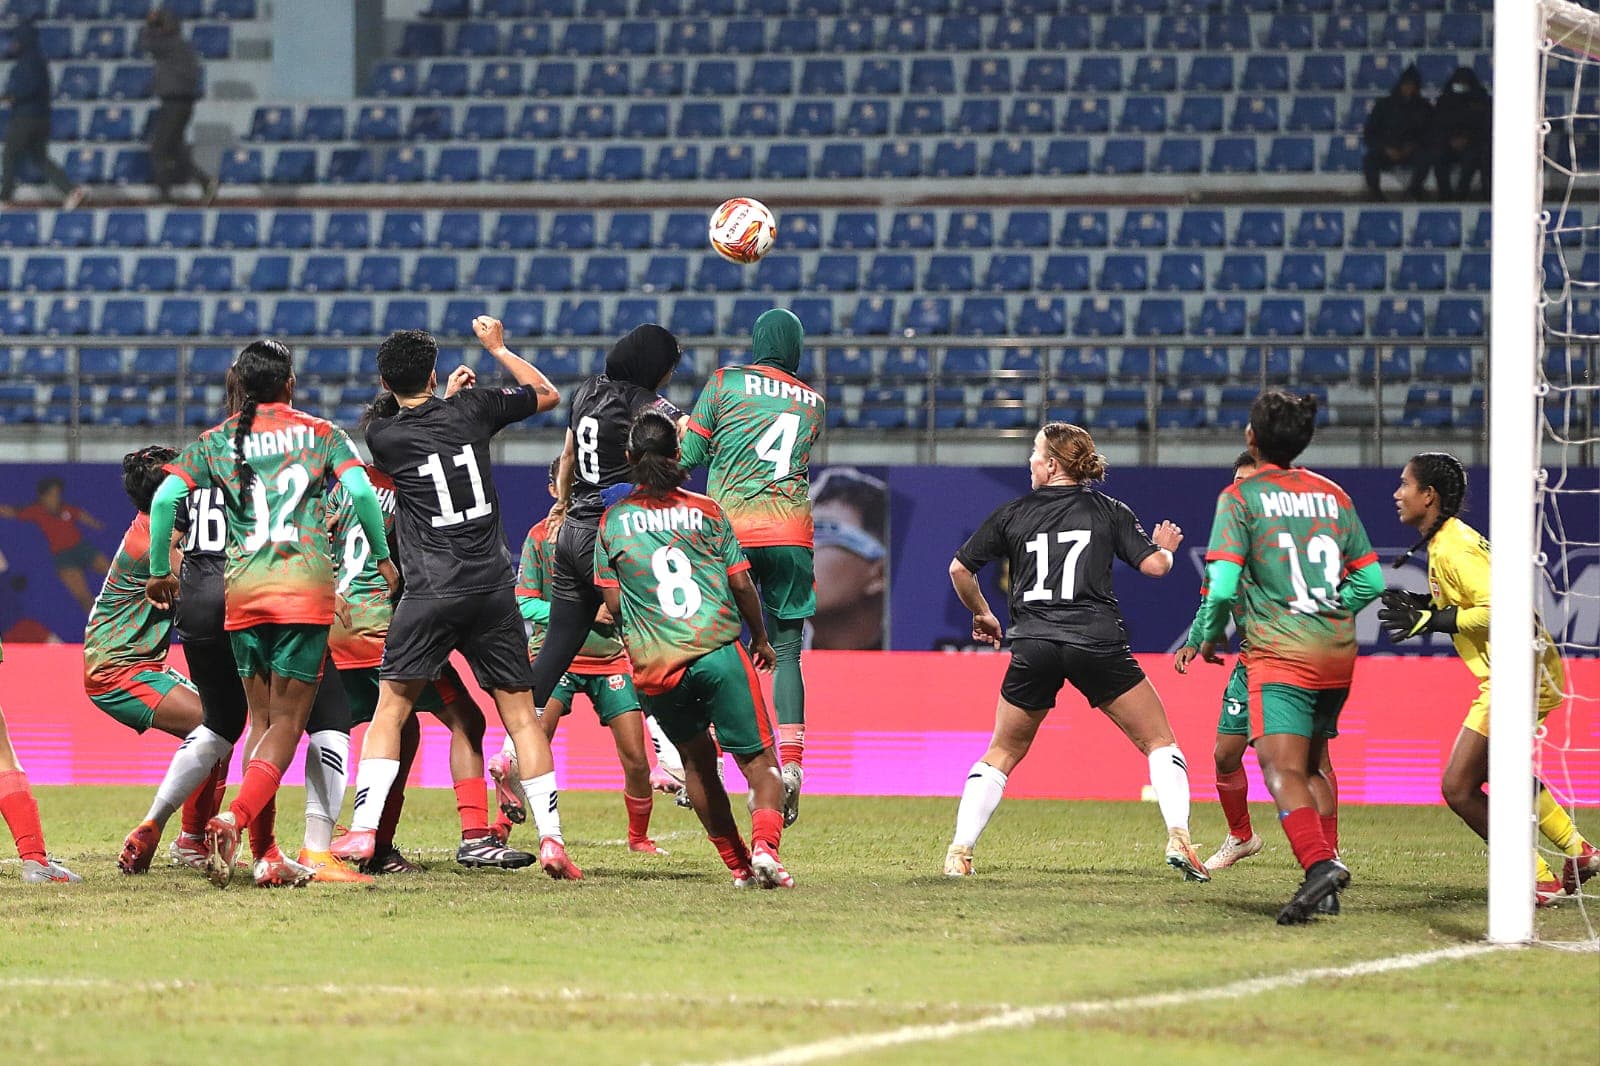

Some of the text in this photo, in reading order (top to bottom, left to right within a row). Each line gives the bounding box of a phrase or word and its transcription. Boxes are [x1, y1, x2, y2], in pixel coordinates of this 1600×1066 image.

[744, 374, 818, 407] RUMA
[576, 415, 600, 485] 8
[755, 412, 802, 480] 4
[417, 443, 493, 528] 11
[1260, 491, 1339, 520] MOMITA
[618, 506, 704, 537] TONIMA
[336, 523, 372, 594] 9
[651, 545, 702, 620] 8
[1022, 529, 1092, 602] 17
[1278, 531, 1342, 615] 13
